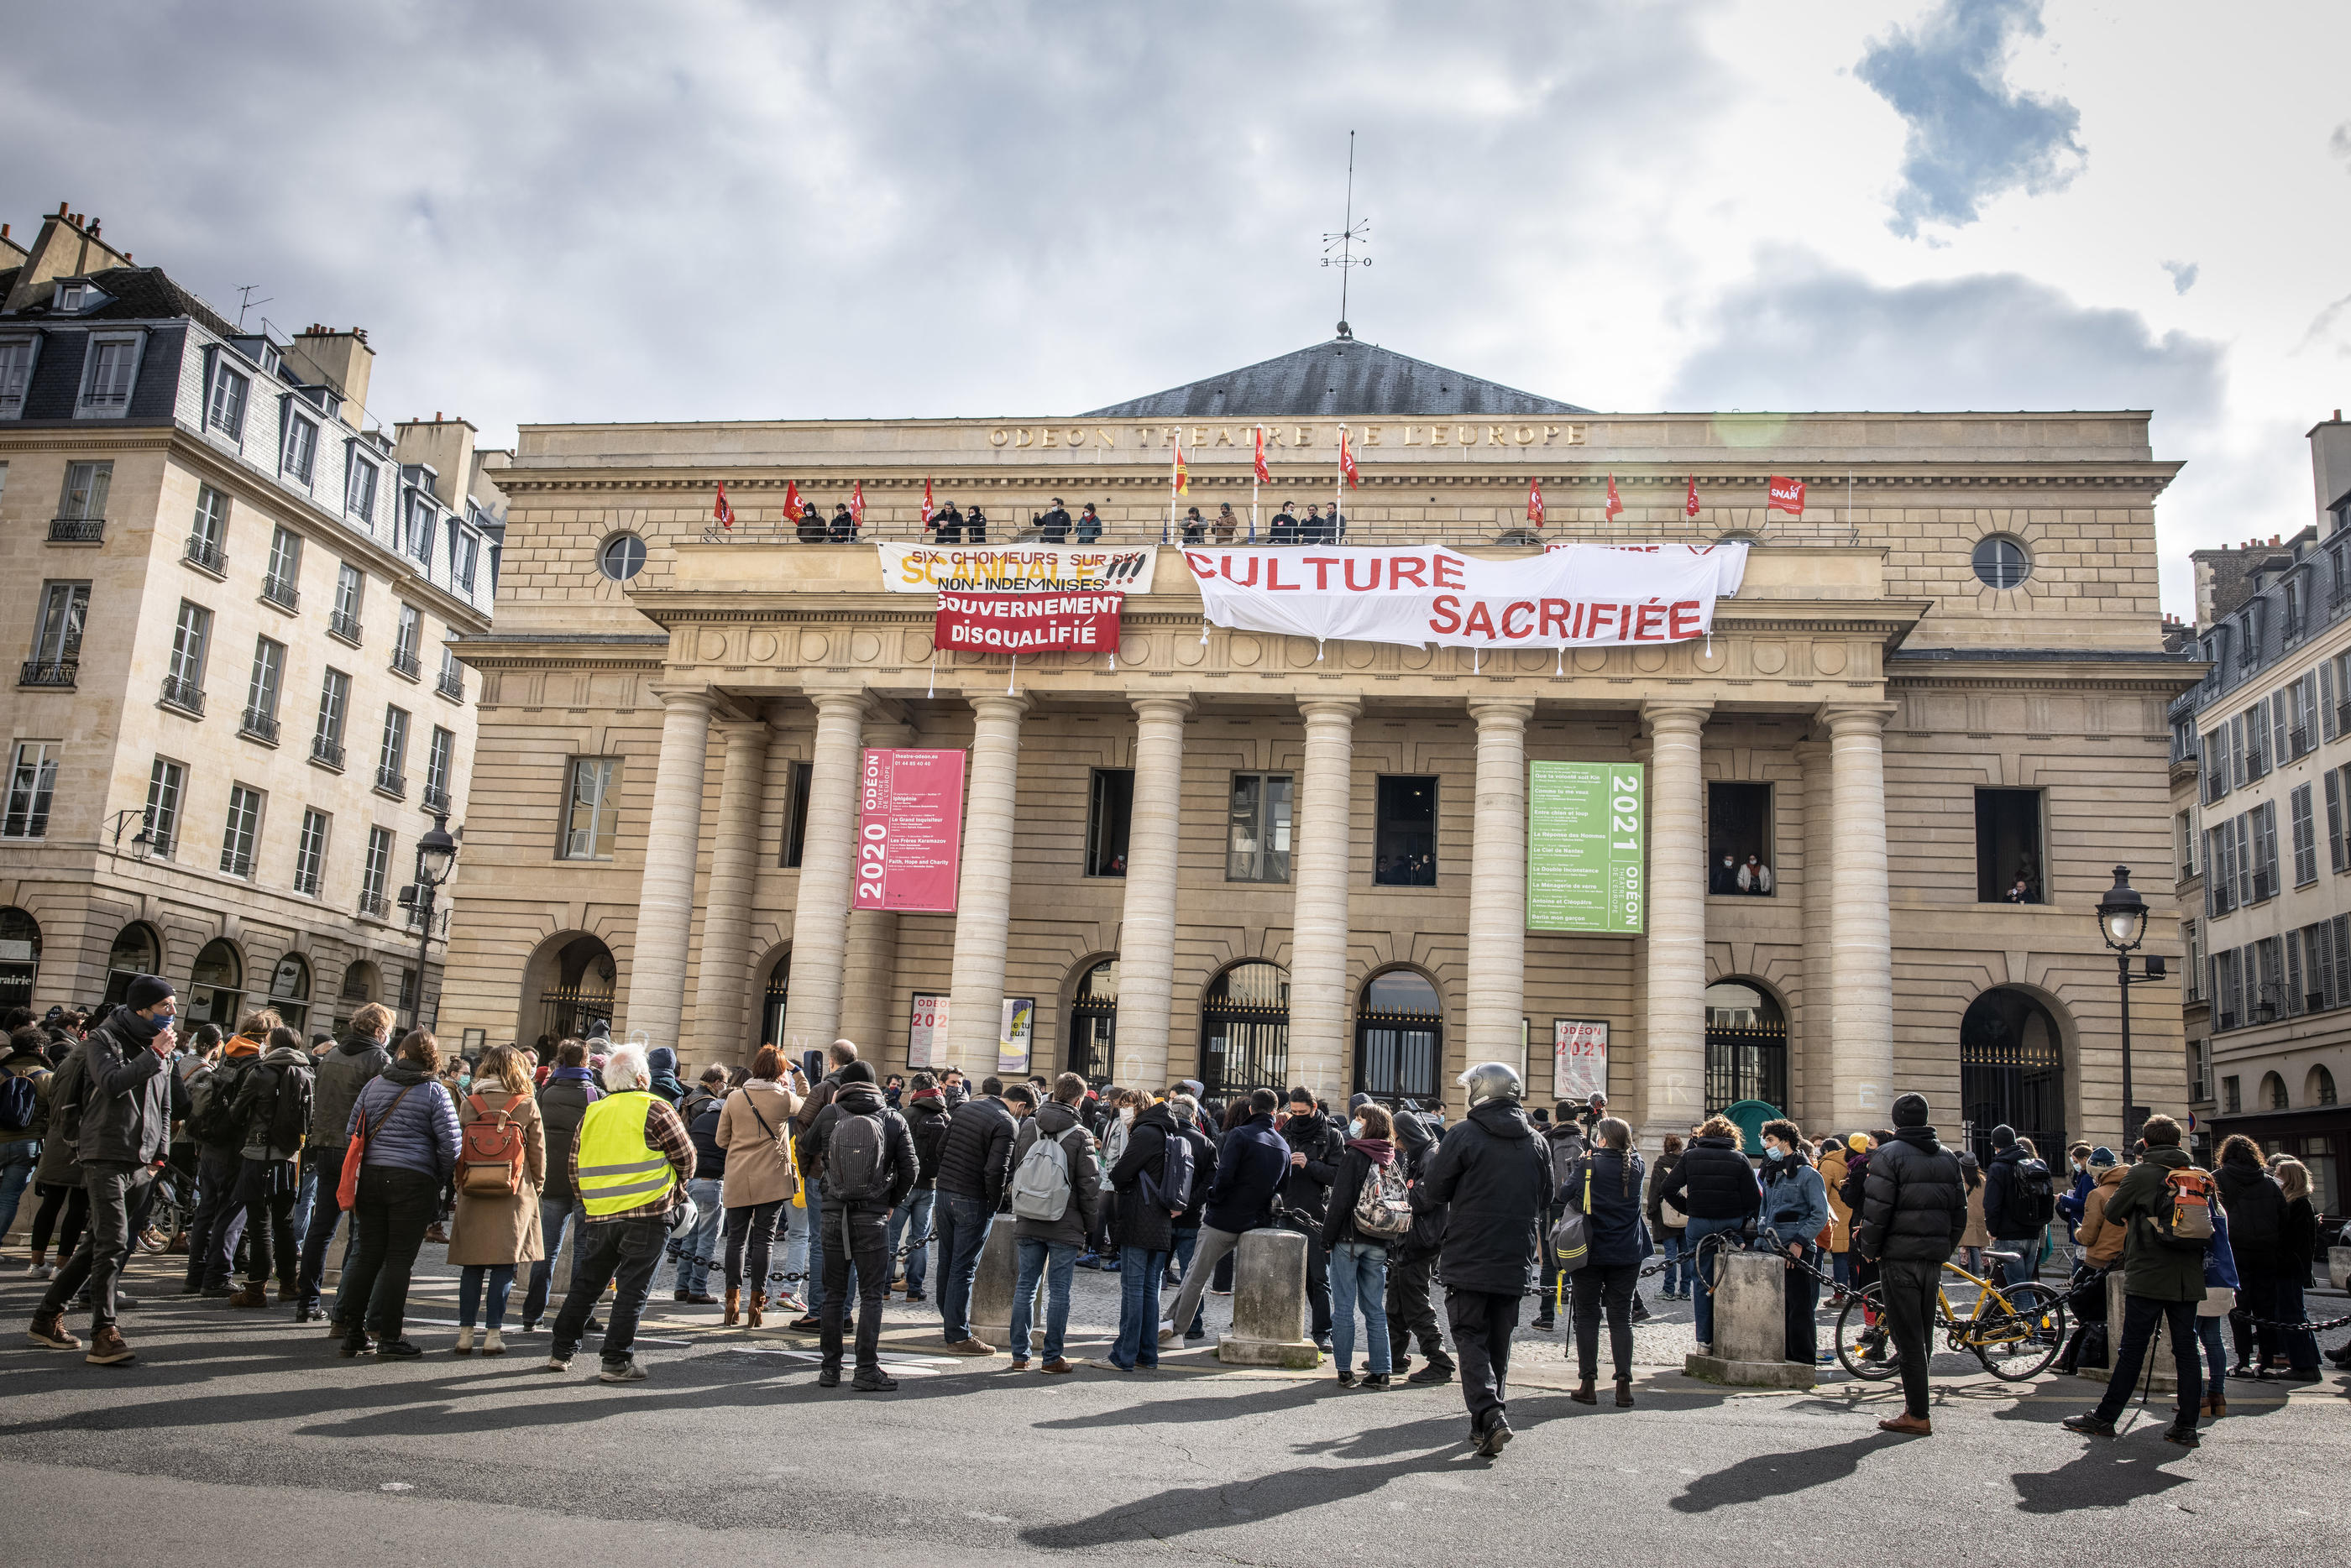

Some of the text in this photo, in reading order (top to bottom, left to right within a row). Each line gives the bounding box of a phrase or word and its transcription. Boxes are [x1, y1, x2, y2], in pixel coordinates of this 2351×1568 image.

[989, 426, 1116, 448] ODEON
[1404, 426, 1586, 447] L'EUROPE
[1771, 489, 1799, 501] SNAM
[912, 551, 1141, 567] SIX CHOMEURS SUR DIX
[1184, 551, 1467, 592] CULTURE
[937, 593, 1123, 618] GOUVERNEMENT
[1428, 594, 1704, 640] SACRIFIÉE
[864, 755, 879, 811] ODÉON
[1613, 776, 1638, 849] 2021
[859, 823, 888, 899] 2020
[1626, 866, 1641, 925] ODÉON
[1556, 1041, 1605, 1057] 2021
